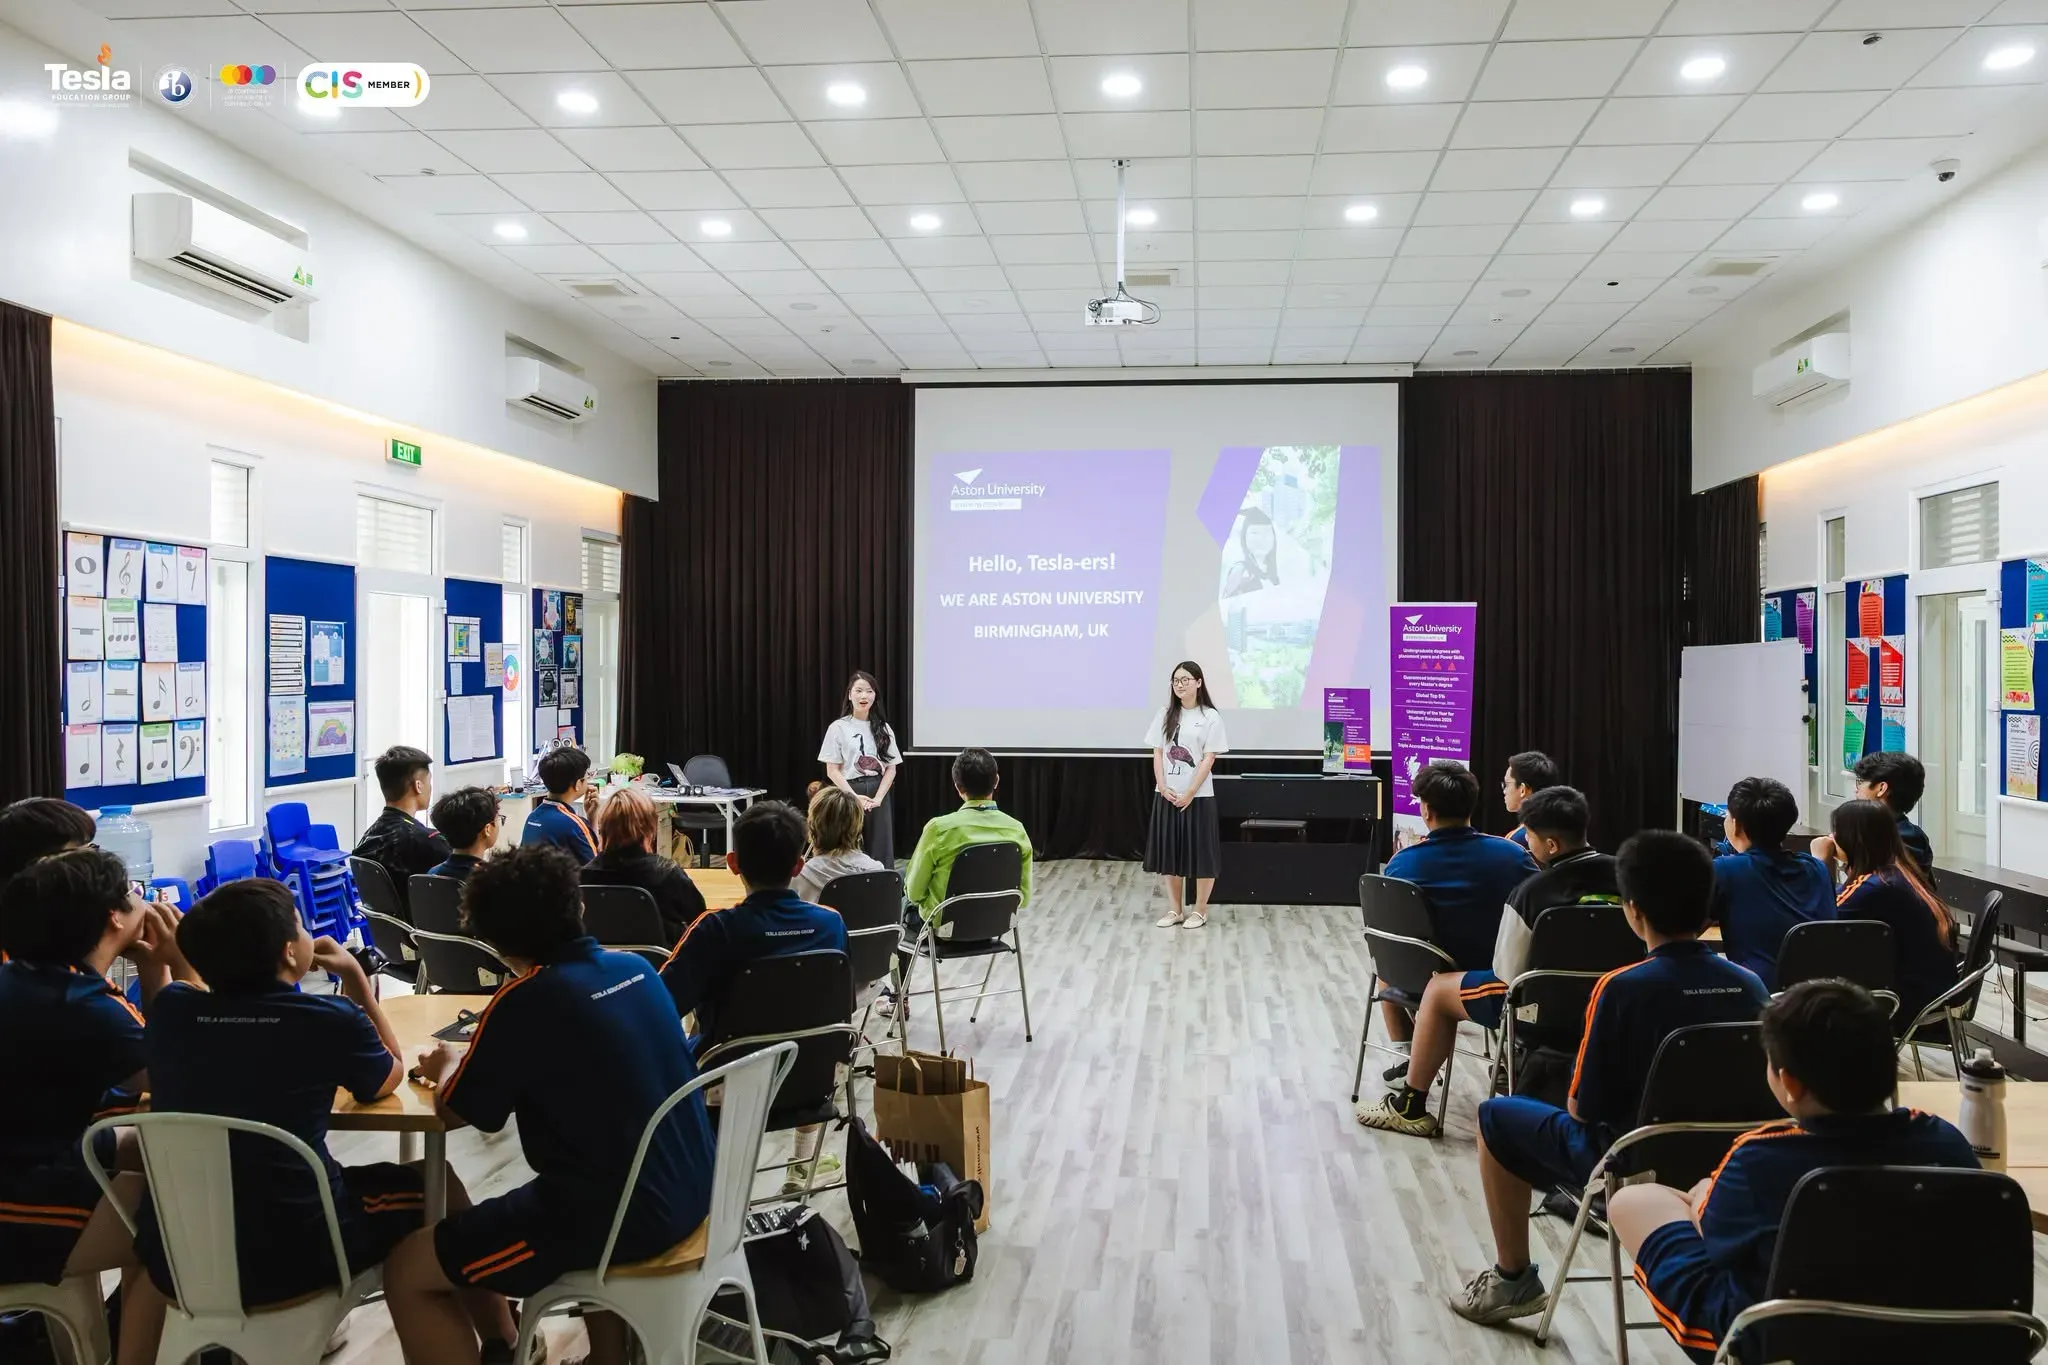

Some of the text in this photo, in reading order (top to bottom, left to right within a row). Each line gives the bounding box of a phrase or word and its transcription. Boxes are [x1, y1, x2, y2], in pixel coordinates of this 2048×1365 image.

[398, 443, 416, 463] EXIT
[951, 483, 1046, 497] Aston University
[969, 552, 1116, 574] Hello, Tesla-ers!
[940, 590, 1144, 607] WE ARE ASTON UNIVERSITY
[974, 623, 1109, 639] BIRMINGHAM, UK
[1403, 624, 1462, 634] Aston University
